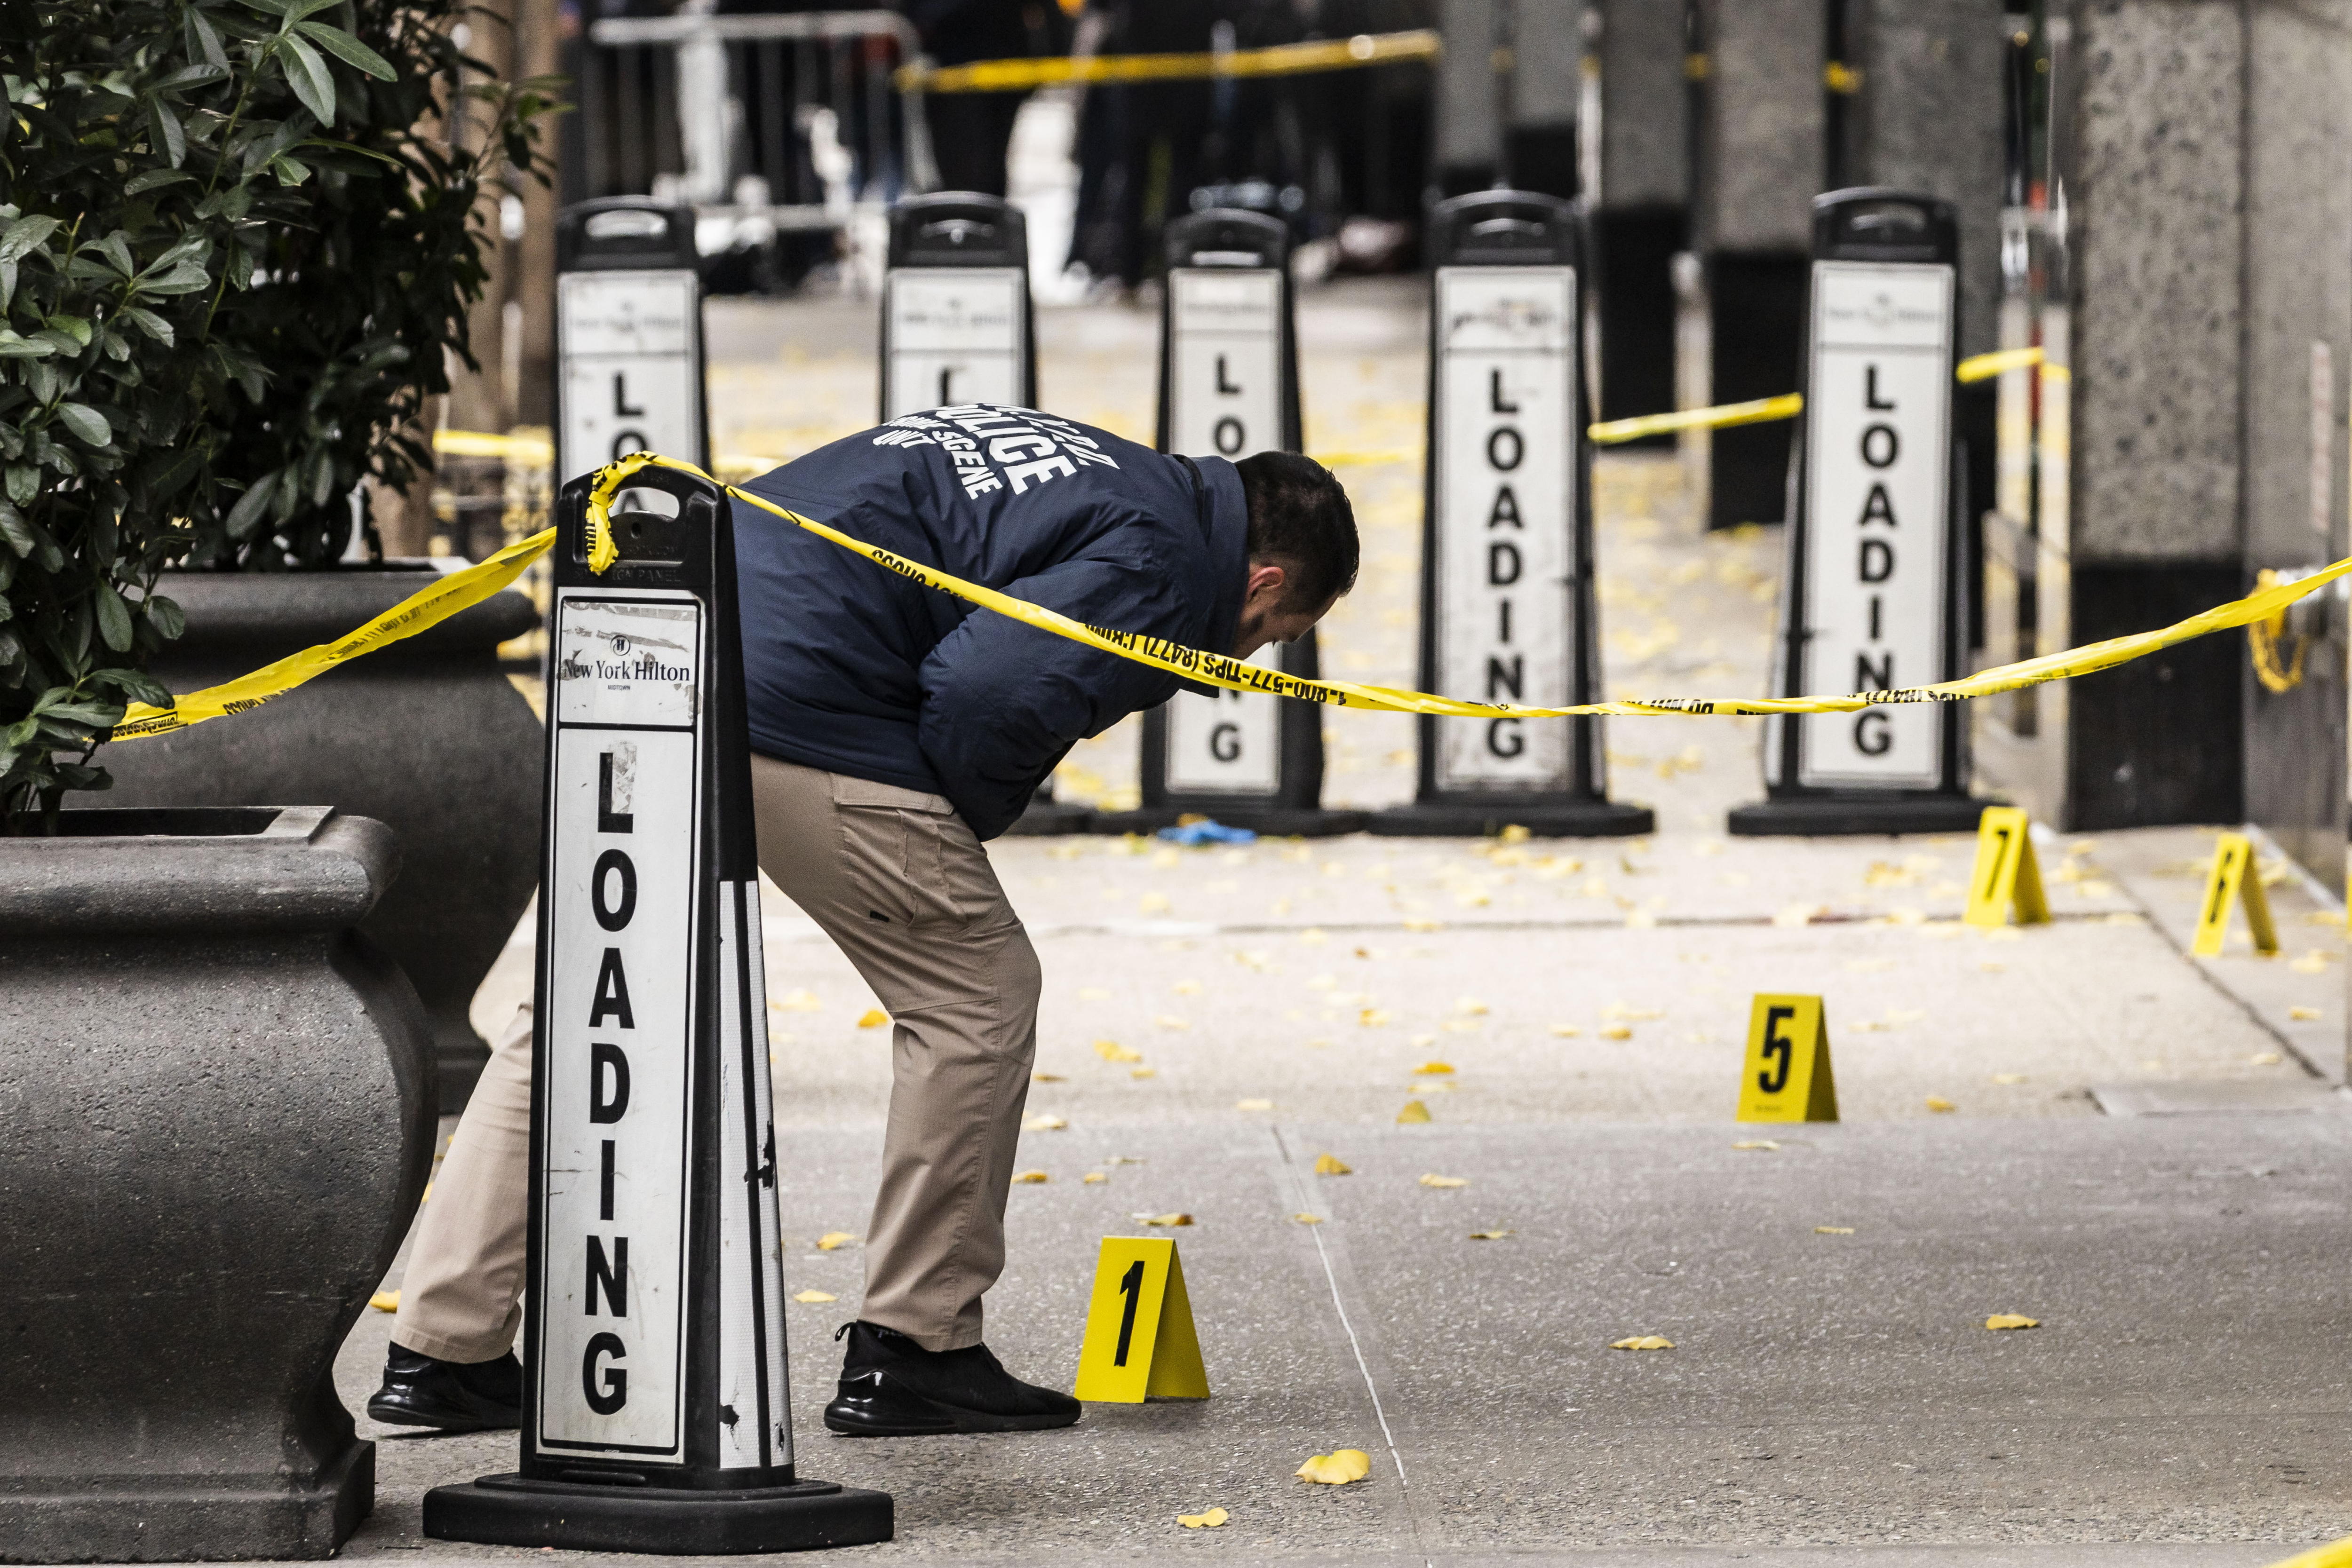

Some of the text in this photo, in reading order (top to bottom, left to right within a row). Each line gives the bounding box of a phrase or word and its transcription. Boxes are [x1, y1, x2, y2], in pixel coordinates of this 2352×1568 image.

[932, 431, 1004, 500] SCENE
[1486, 369, 1524, 760] LOADING
[1854, 365, 1899, 757] LOADING
[564, 659, 690, 681] New York Hilton
[582, 752, 637, 1416] LOADING
[1758, 1006, 1795, 1094] 5
[1114, 1260, 1145, 1367] 1
